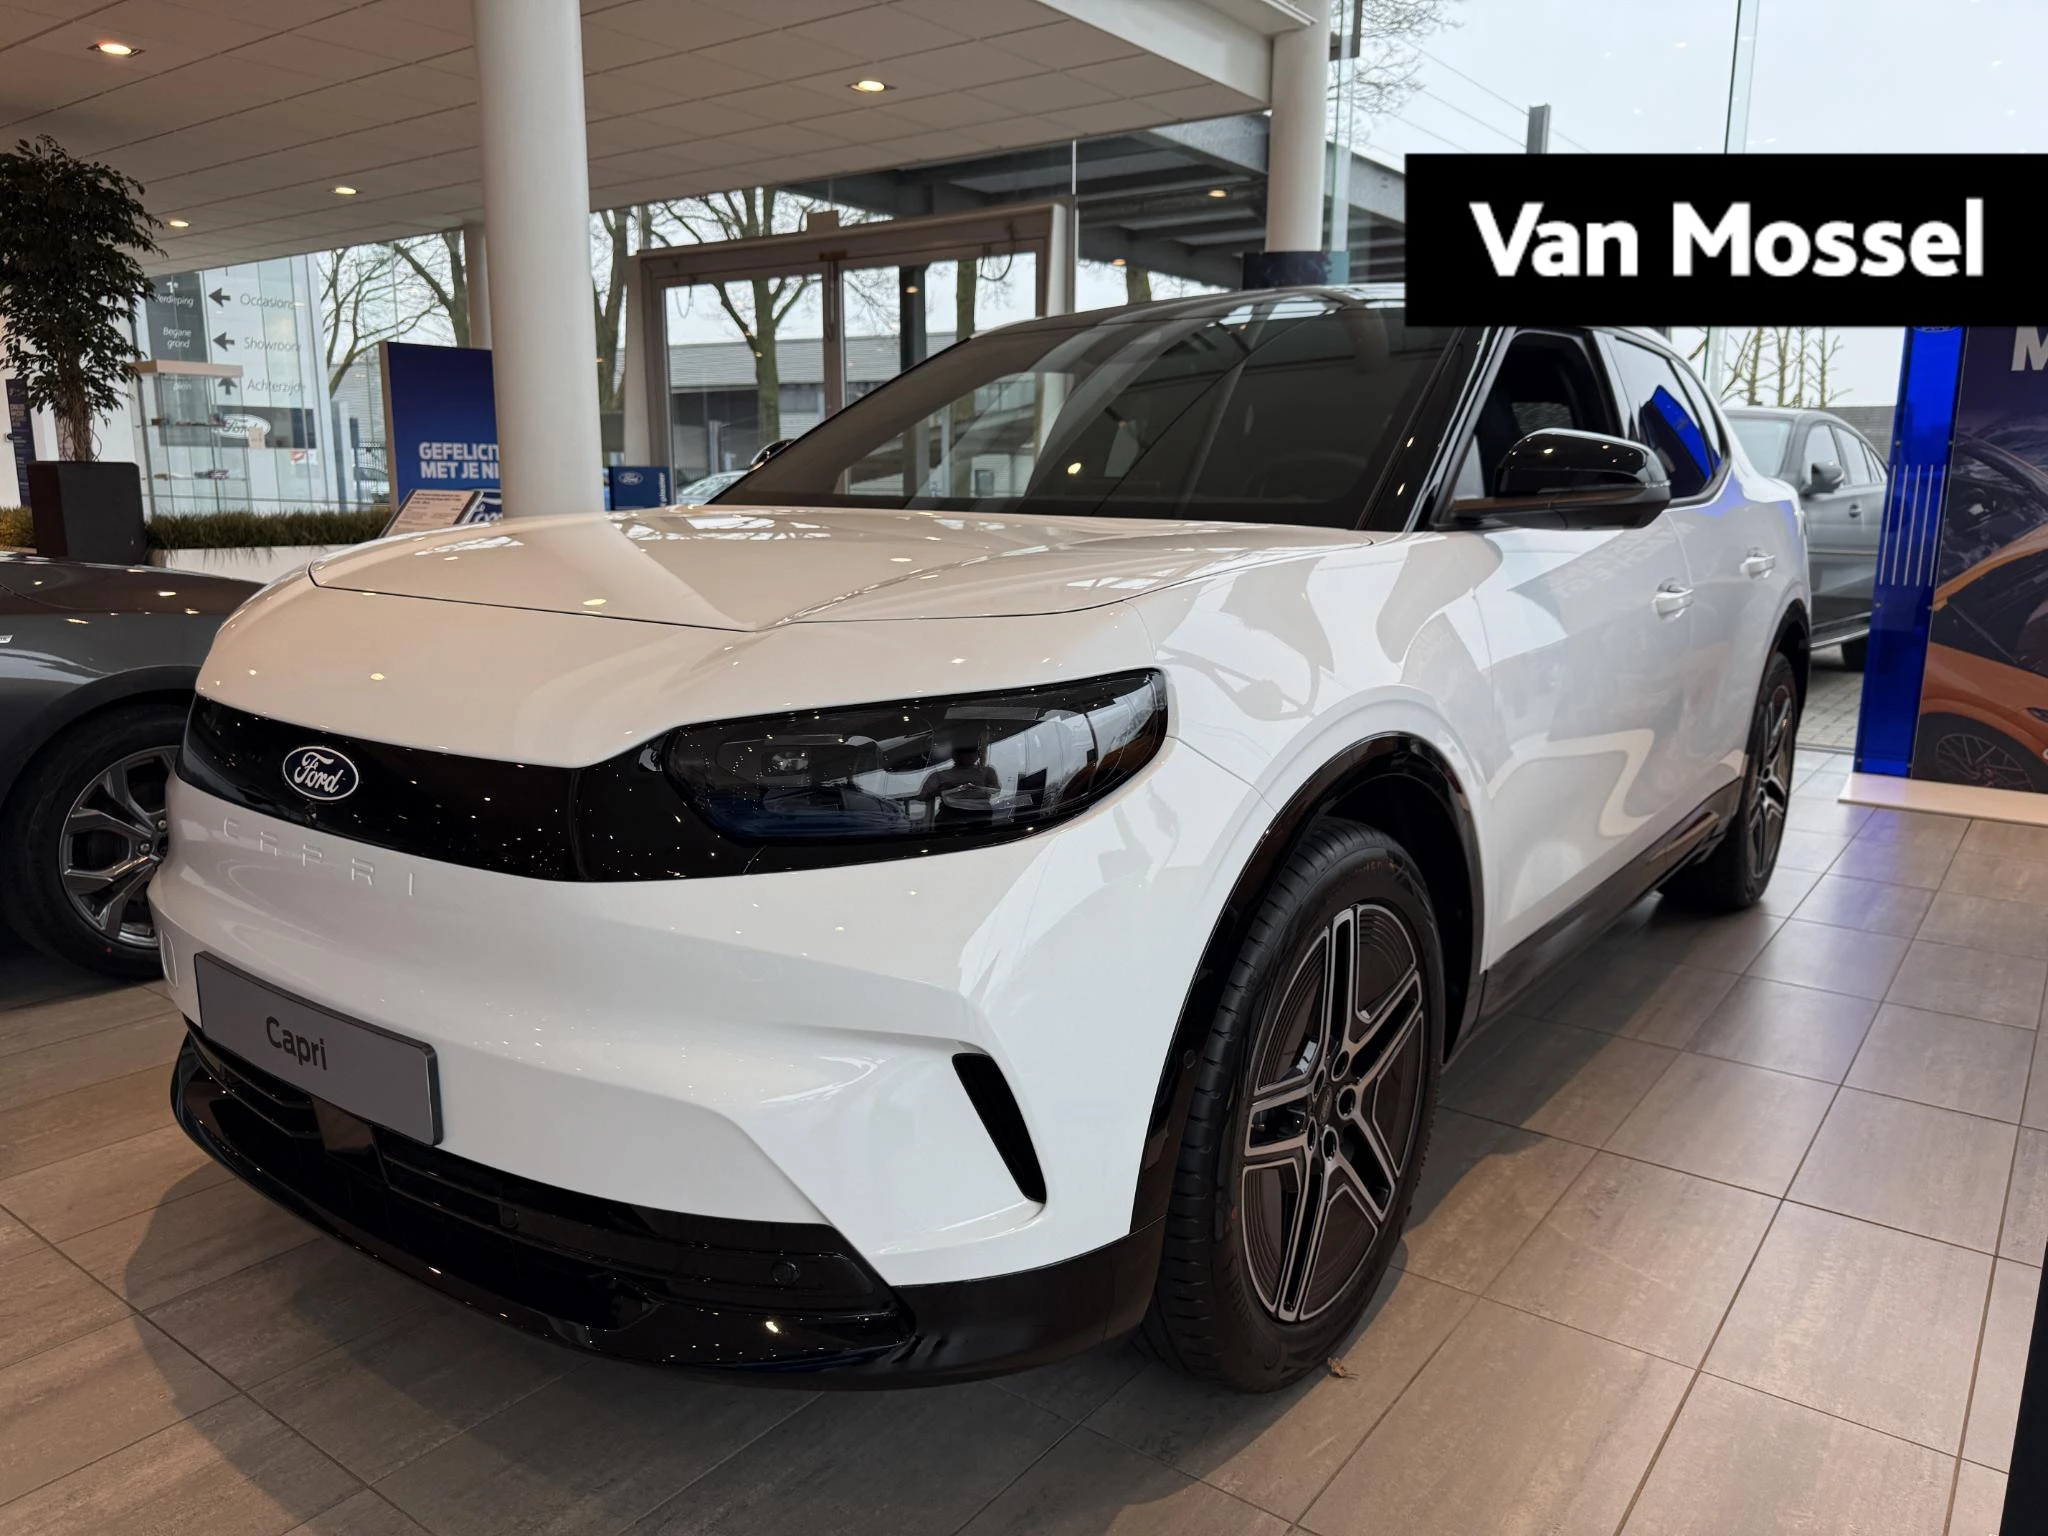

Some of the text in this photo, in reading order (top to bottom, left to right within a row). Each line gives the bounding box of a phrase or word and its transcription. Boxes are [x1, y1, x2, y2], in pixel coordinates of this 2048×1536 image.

[163, 326, 192, 339] Begane
[167, 340, 191, 350] grond
[421, 461, 459, 479] MET
[461, 461, 480, 479] JE
[294, 751, 345, 793] Ford
[223, 817, 415, 896] CAPRI
[266, 1016, 327, 1071] Capri
